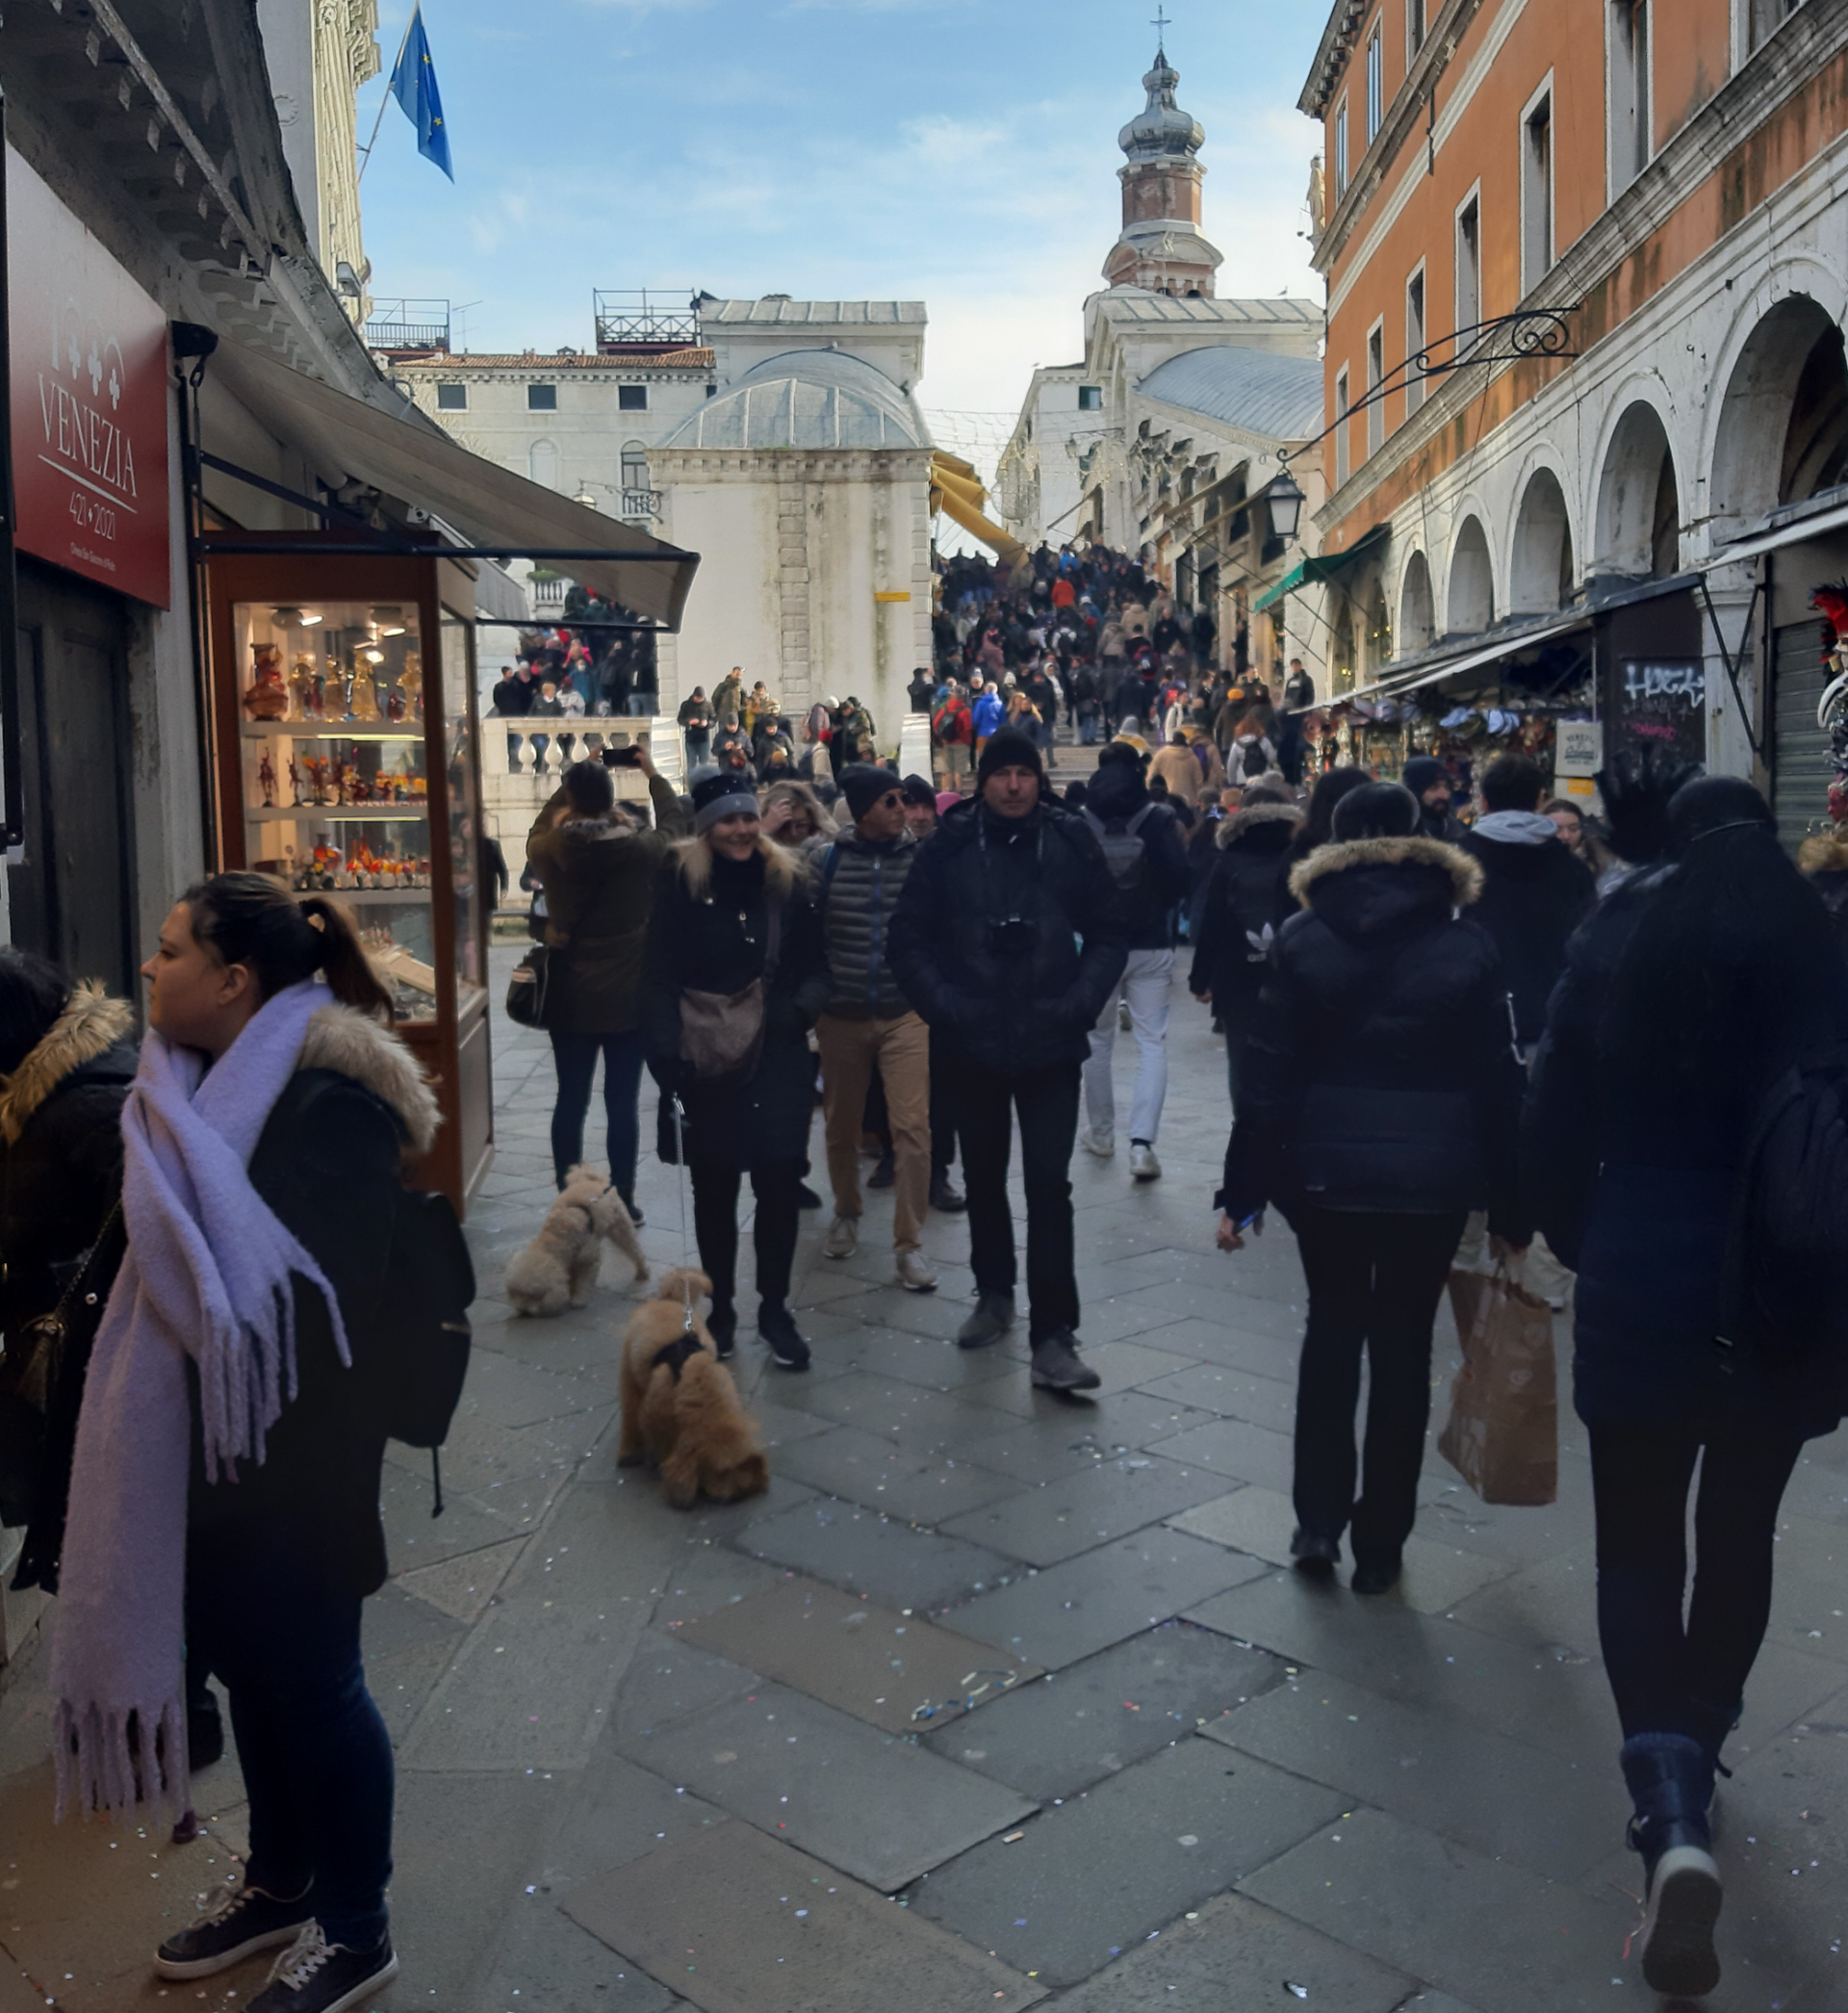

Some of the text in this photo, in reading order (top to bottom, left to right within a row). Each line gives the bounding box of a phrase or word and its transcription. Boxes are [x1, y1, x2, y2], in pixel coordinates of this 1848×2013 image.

[38, 372, 138, 498] VENEZIA
[69, 491, 116, 541] 421 2021
